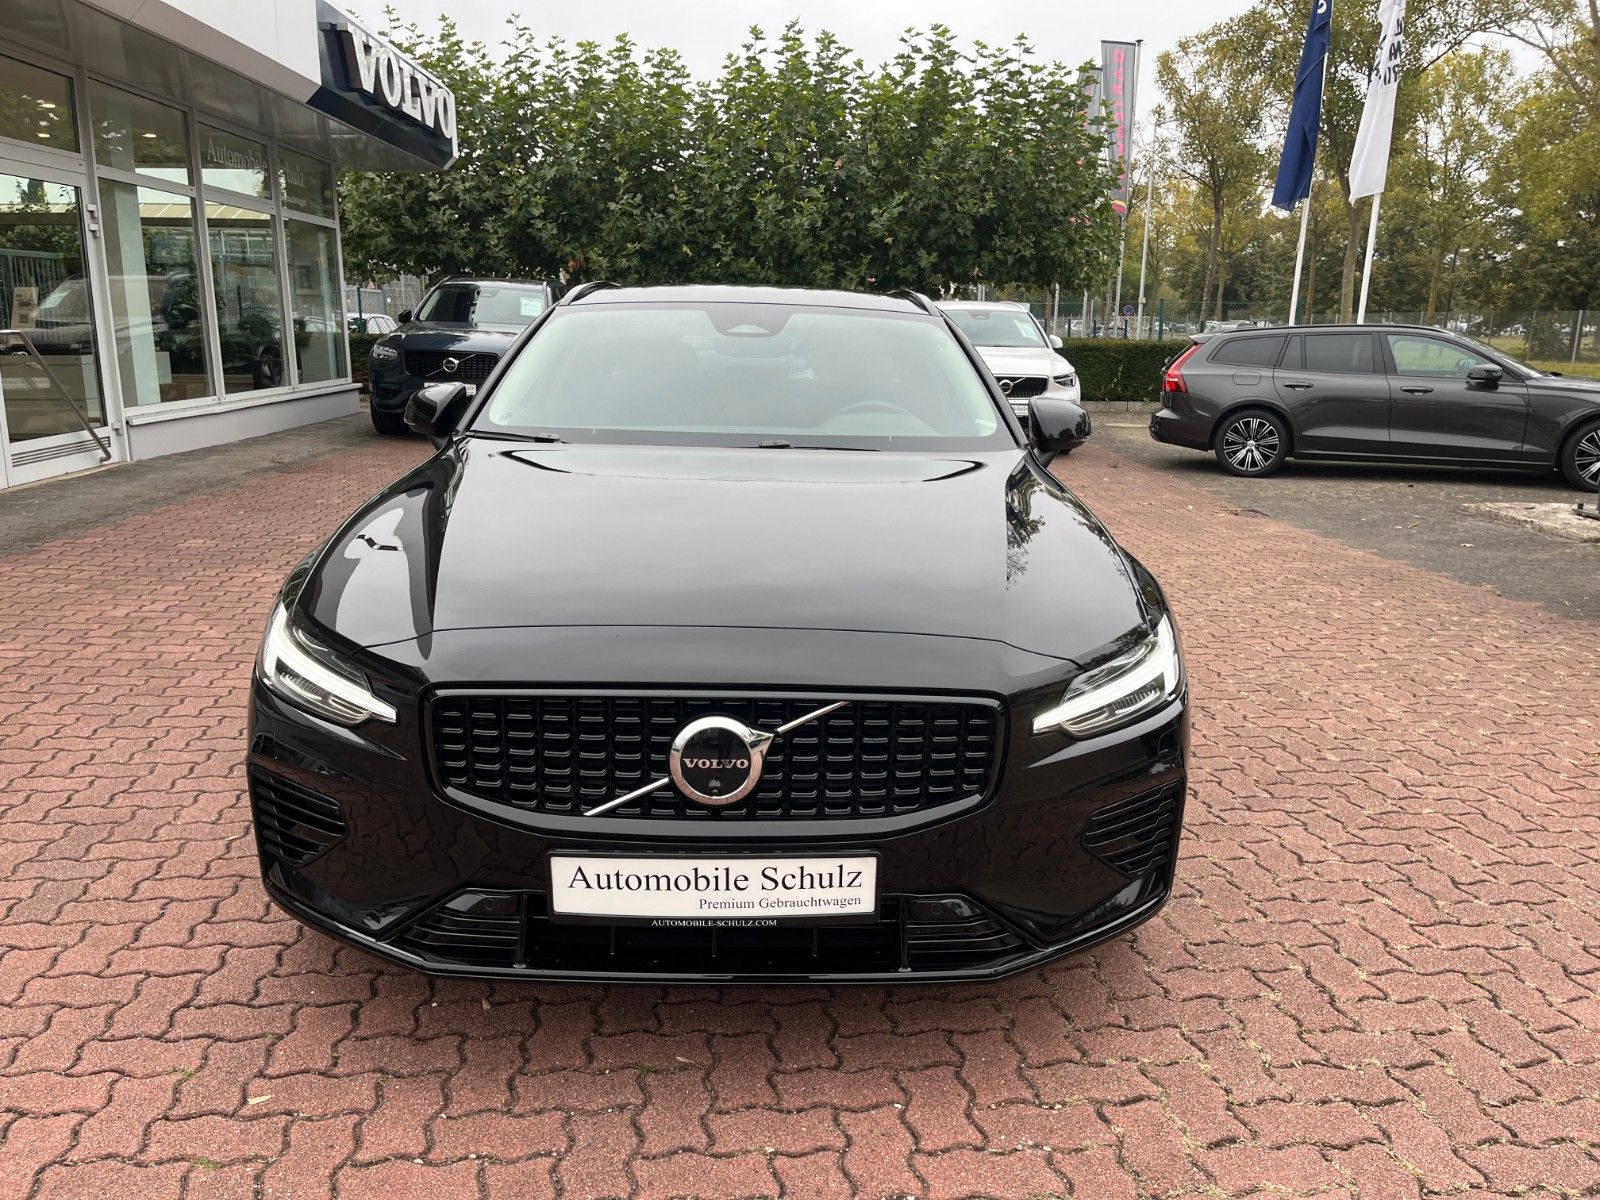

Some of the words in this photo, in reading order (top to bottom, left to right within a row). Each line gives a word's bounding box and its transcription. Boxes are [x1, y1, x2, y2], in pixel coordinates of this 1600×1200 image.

[347, 22, 453, 139] VOLVO
[683, 758, 749, 769] VOLVO
[567, 865, 750, 892] Automobile
[761, 864, 863, 891] Schulz
[699, 898, 755, 909] Premium
[758, 896, 861, 908] Gebrauchtwagen
[651, 919, 777, 927] AUTOMOBILE-SCHULZ.COM
